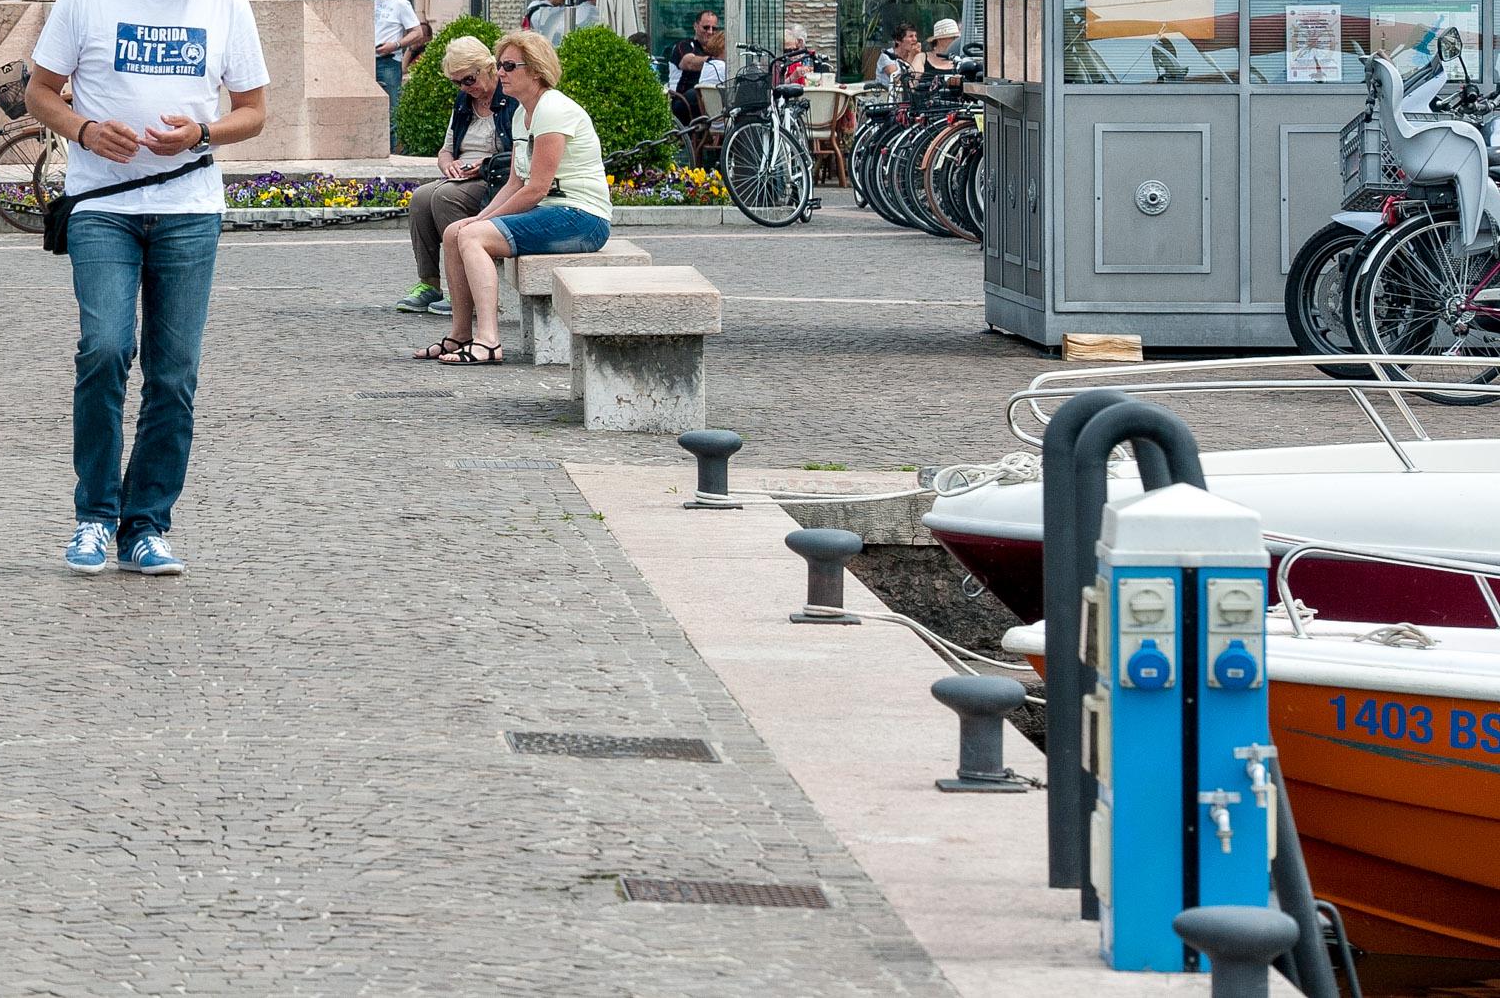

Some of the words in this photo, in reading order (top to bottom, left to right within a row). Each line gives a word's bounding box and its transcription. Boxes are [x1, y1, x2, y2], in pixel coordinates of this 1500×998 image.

[136, 26, 189, 42] FLORIDA
[126, 62, 140, 73] THE
[140, 64, 175, 75] SUNSHINE
[175, 65, 196, 75] STATE
[1329, 694, 1434, 744] 1403
[1449, 709, 1500, 754] BS
